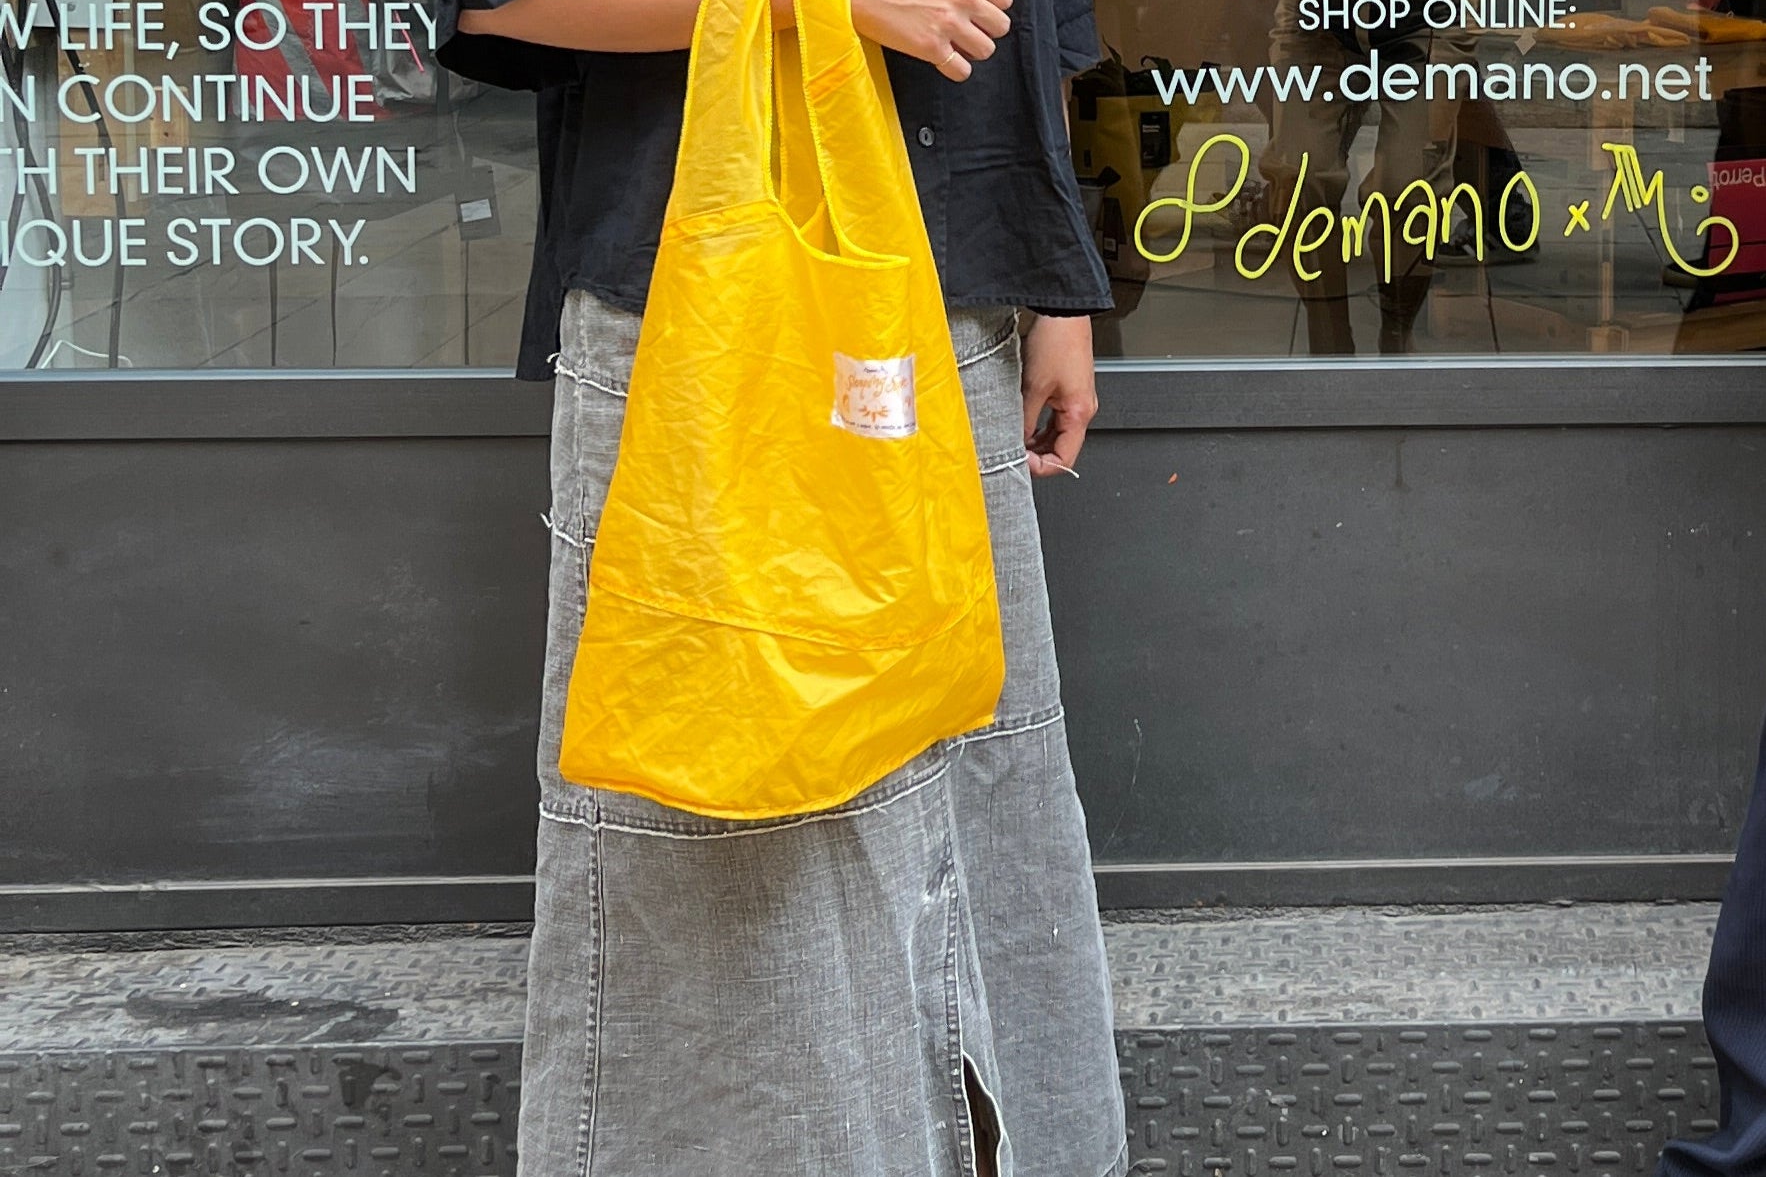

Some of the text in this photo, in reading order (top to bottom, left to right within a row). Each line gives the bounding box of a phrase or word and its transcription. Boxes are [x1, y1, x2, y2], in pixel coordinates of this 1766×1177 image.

[60, 2, 181, 61] LIFE,
[198, 1, 287, 52] SO
[303, 2, 438, 51] THEY
[57, 74, 375, 123] CONTINUE
[1151, 50, 1713, 106] www.demano.net
[74, 146, 239, 195] THEIR
[257, 145, 417, 195] OWN
[166, 216, 370, 267] STORY.
[1234, 152, 1541, 284] demano
